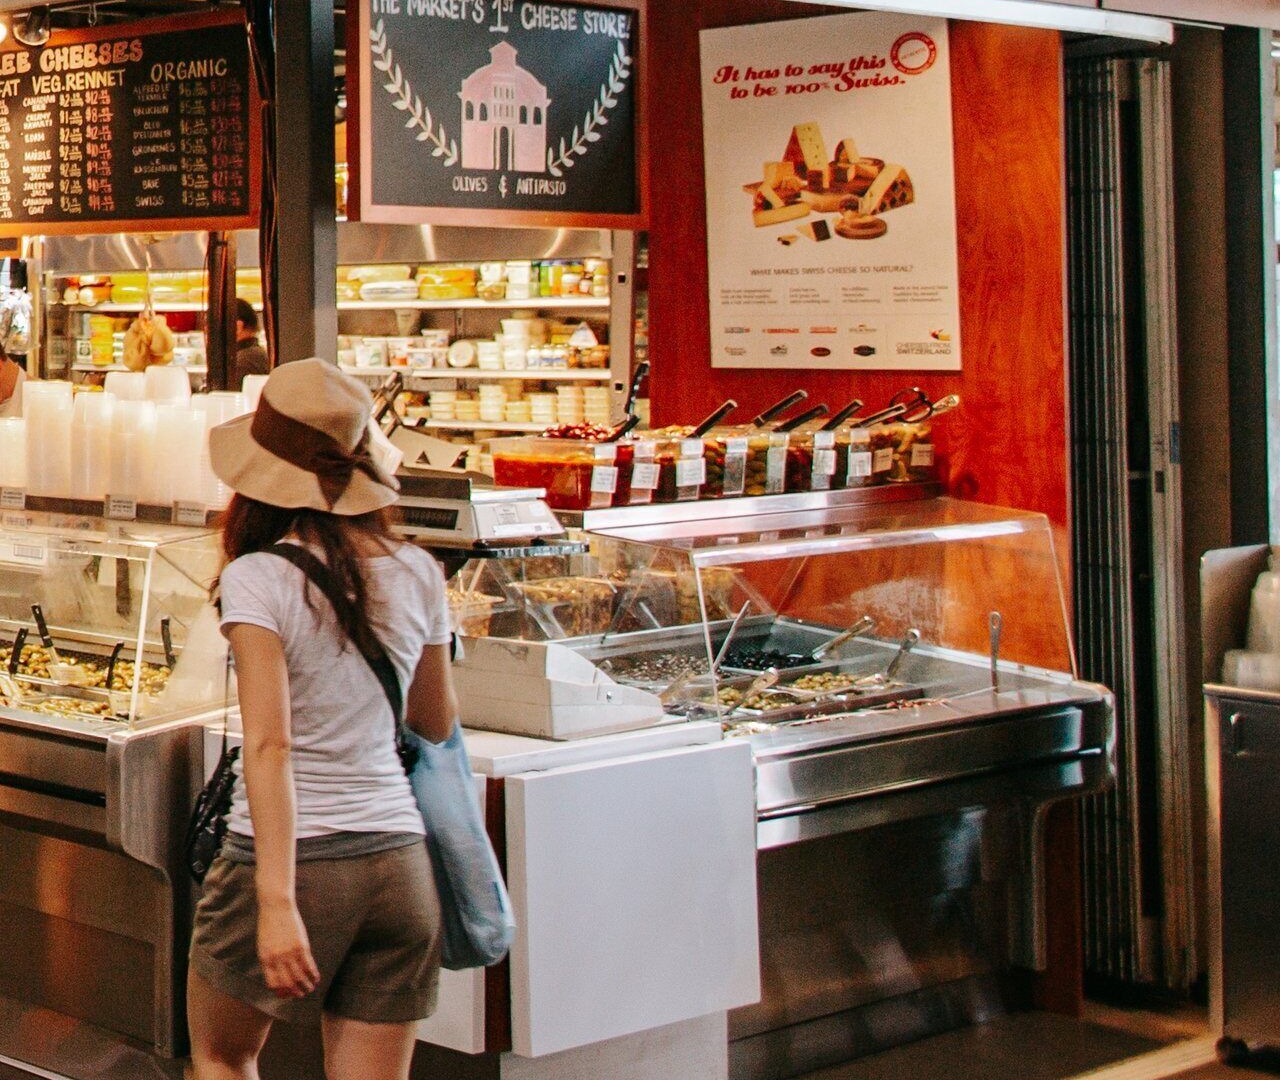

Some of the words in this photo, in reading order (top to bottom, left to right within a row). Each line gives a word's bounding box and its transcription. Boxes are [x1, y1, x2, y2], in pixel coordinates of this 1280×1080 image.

[521, 2, 577, 31] CHEESE
[582, 11, 631, 39] STORE!
[39, 39, 144, 72] CHEESES
[713, 65, 740, 84] It
[744, 67, 780, 81] has
[784, 64, 803, 78] to
[808, 62, 846, 79] say
[848, 55, 885, 71] this
[150, 58, 228, 83] ORGANIC
[730, 86, 749, 99] to
[753, 84, 777, 97] be
[834, 71, 906, 92] Swiss.
[452, 176, 488, 193] OLIVES
[516, 178, 567, 195] ANTIPASTO
[135, 196, 165, 207] SWISS
